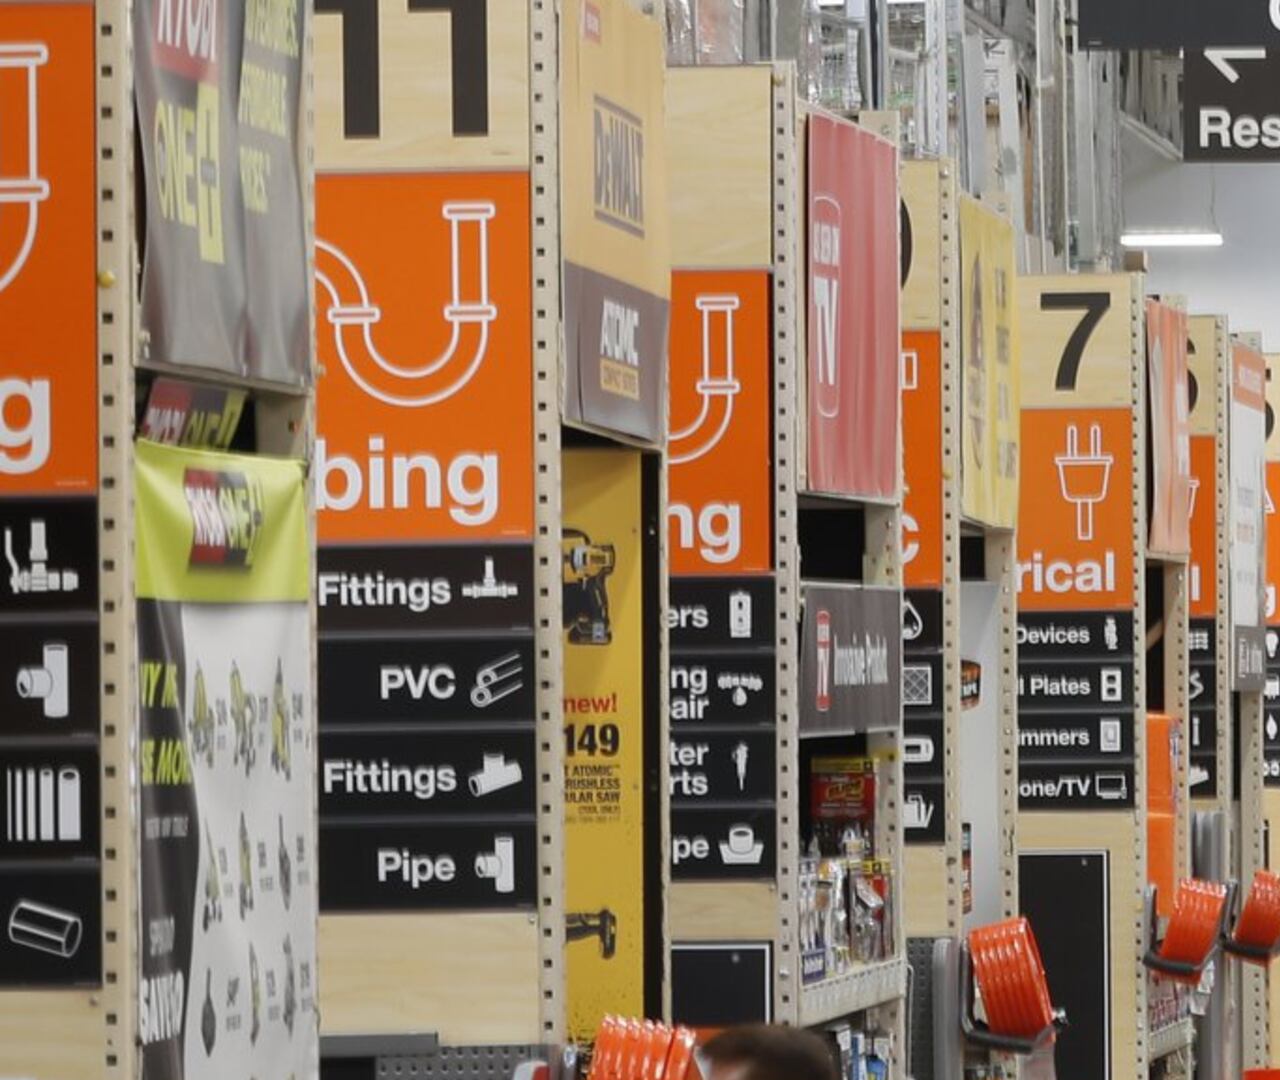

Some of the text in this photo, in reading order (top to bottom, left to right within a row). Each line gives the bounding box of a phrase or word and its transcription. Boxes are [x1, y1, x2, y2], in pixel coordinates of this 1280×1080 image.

[1039, 292, 1111, 391] 7
[317, 573, 451, 611] Fittings
[379, 666, 456, 700] PVC
[1029, 677, 1091, 697] Plates
[1017, 727, 1091, 747] immers
[322, 760, 457, 798] Fittings
[377, 849, 456, 886] Pipe
